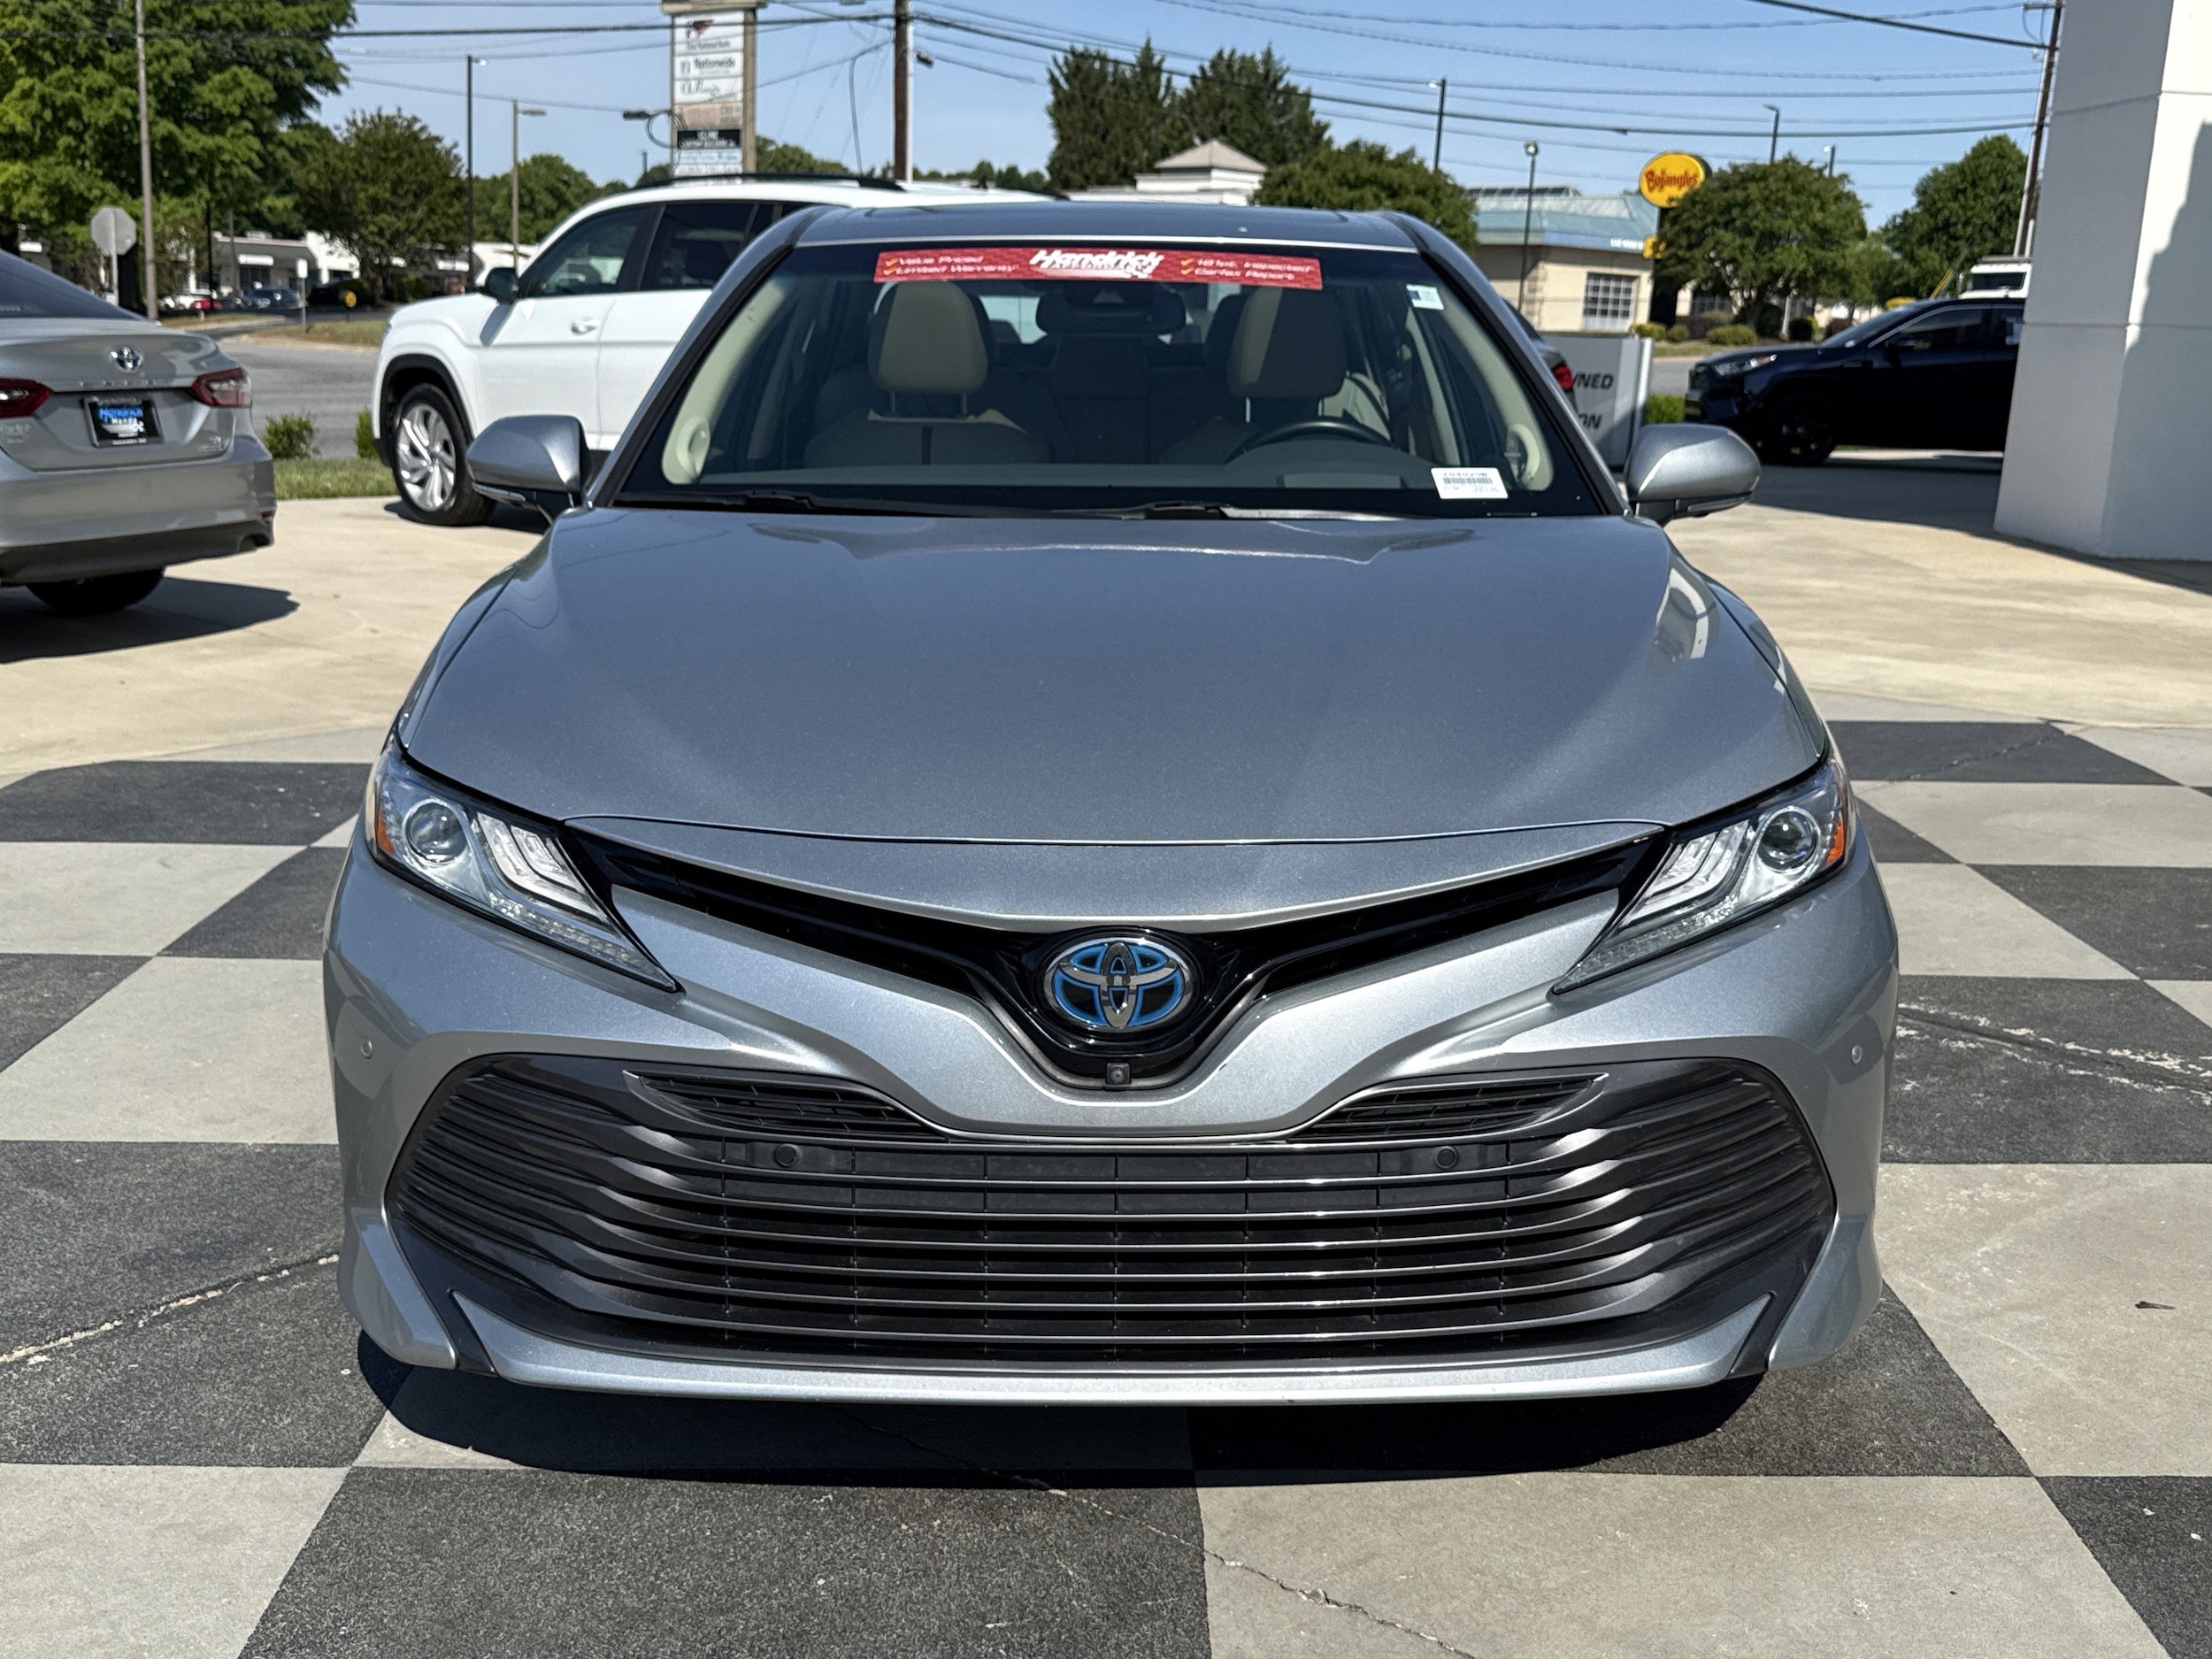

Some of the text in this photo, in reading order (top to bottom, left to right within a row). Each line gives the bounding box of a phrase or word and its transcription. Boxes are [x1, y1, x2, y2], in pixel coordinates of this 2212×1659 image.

[694, 58, 736, 70] Nationwide
[1029, 250, 1165, 274] Hendrick
[1573, 373, 1614, 389] NED
